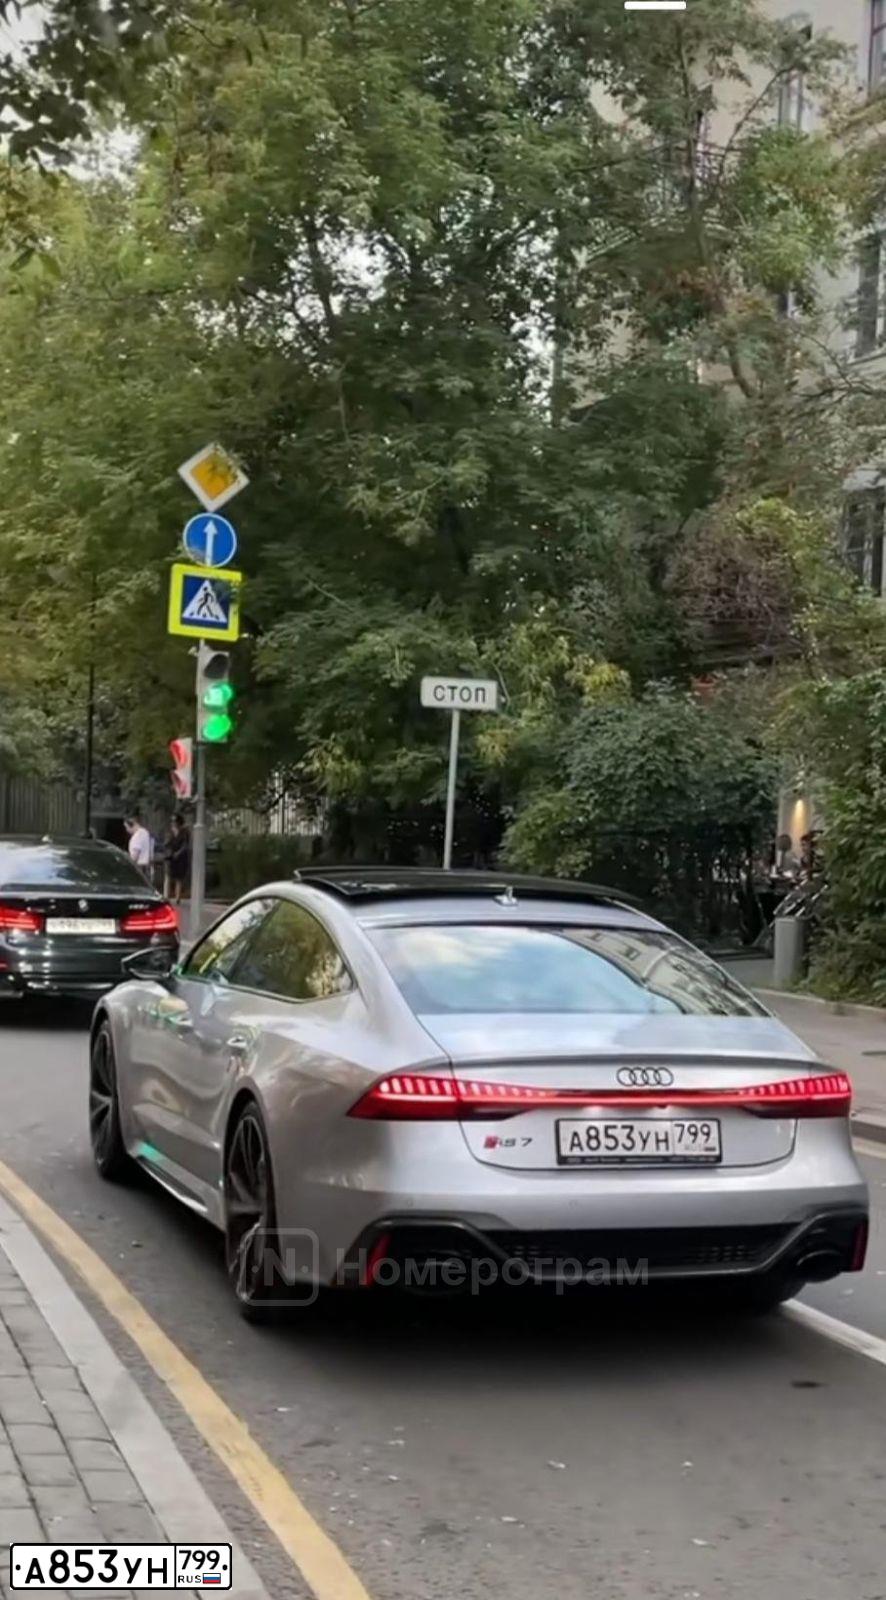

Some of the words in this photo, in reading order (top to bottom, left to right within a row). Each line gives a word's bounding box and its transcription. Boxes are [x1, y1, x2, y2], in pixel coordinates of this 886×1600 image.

[433, 685, 486, 703] СТОП
[568, 1124, 670, 1152] А853УН
[673, 1123, 712, 1144] 799
